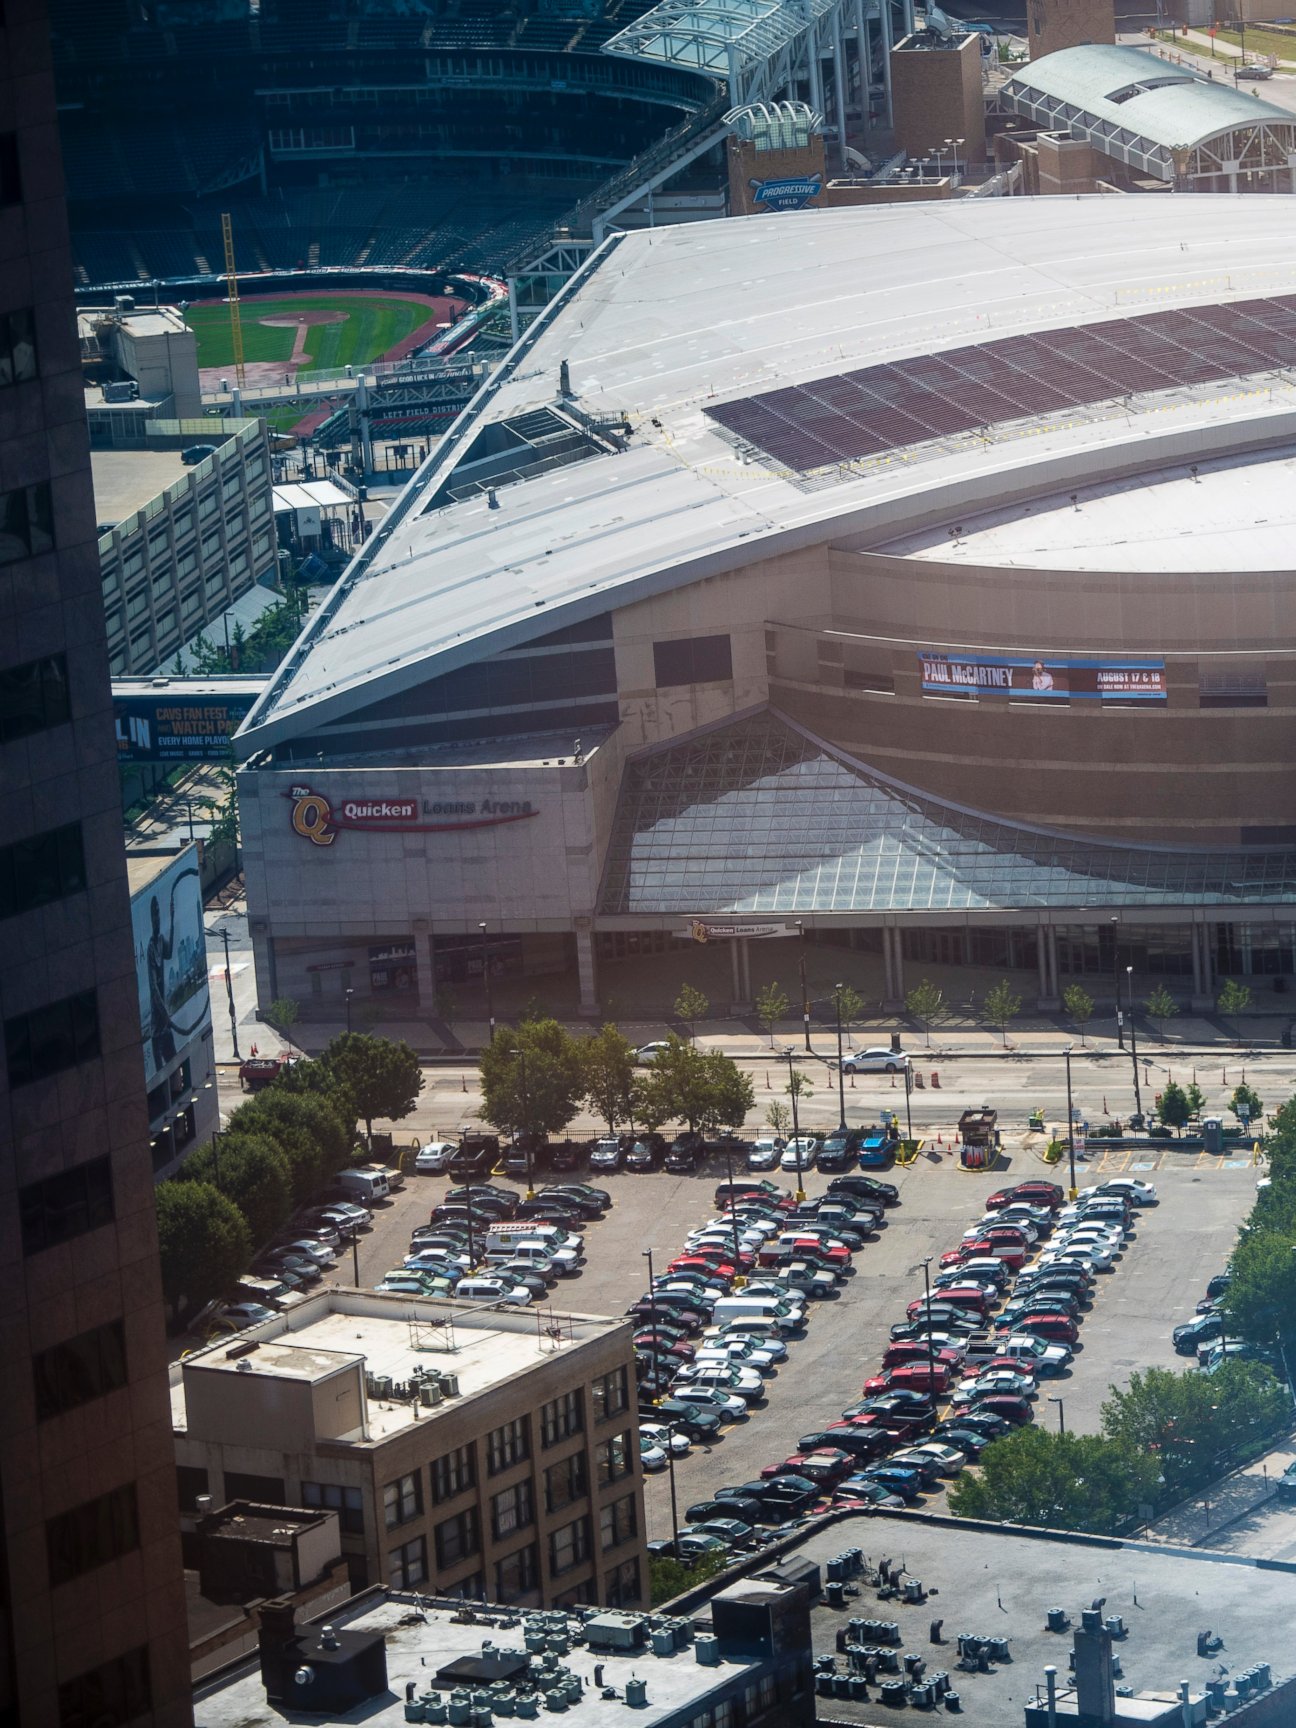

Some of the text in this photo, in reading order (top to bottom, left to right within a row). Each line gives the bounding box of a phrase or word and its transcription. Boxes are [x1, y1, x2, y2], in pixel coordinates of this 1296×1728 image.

[762, 185, 816, 198] PROGRESSIVE
[399, 375, 413, 383] GOOD
[414, 374, 428, 382] LUCK
[383, 403, 466, 419] LEFT FIELD DISTRIC
[923, 663, 1014, 687] PAUL McCARTNEY
[1097, 672, 1128, 682] AUGUST
[1131, 672, 1140, 682] 17
[1151, 672, 1161, 682] 18
[156, 708, 182, 720] CAVS
[183, 707, 201, 720] FAN
[204, 707, 228, 720] FEST
[172, 721, 214, 735] WATCH
[158, 736, 181, 746] EVERY
[182, 736, 204, 745] HOME
[292, 787, 309, 796] The
[292, 795, 532, 845] Q Quicken Loans Arena
